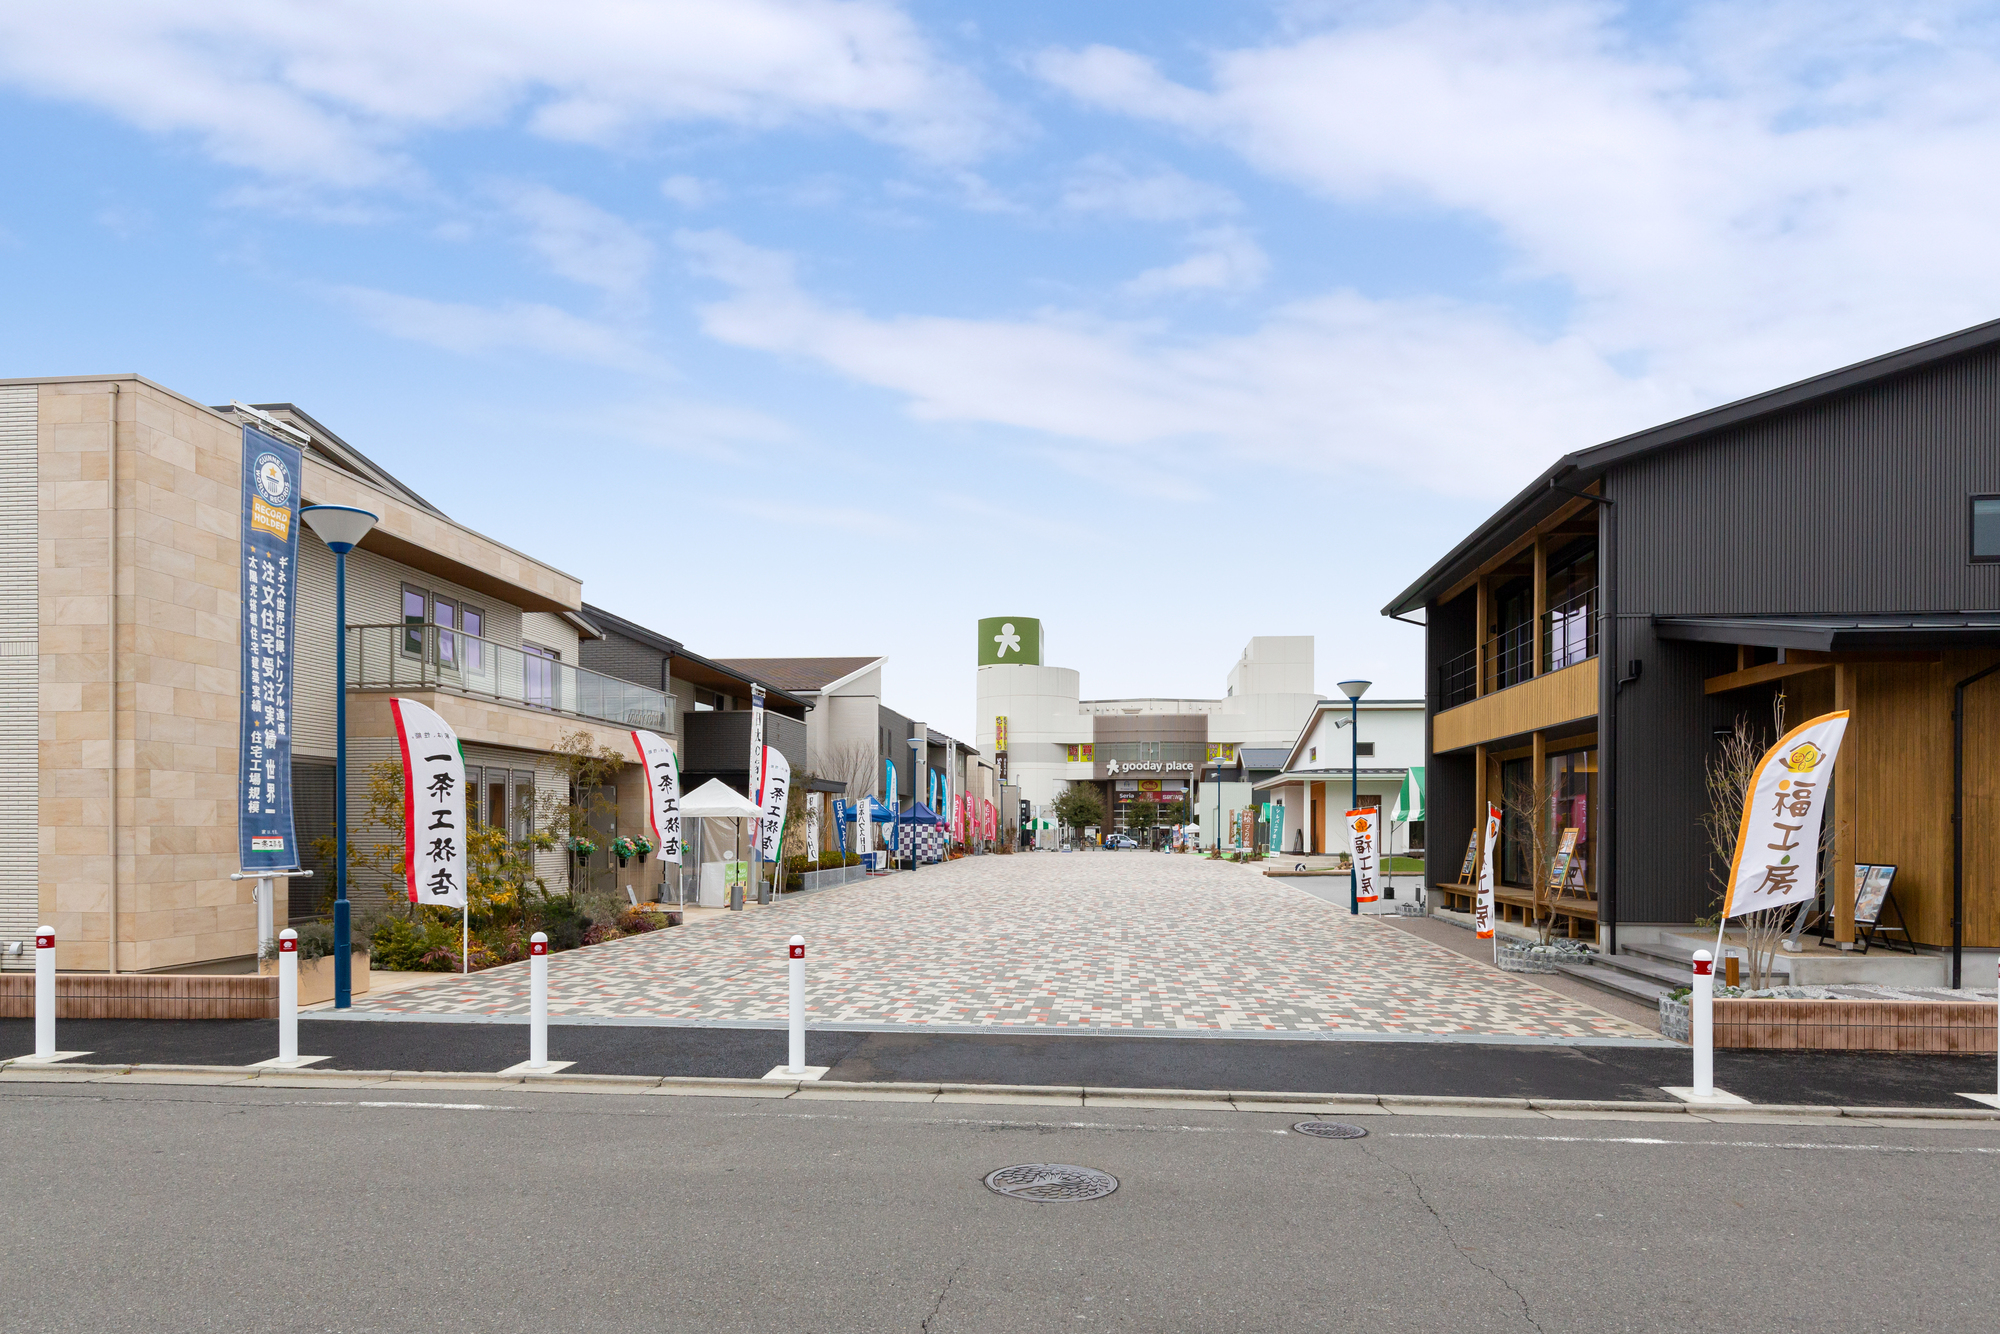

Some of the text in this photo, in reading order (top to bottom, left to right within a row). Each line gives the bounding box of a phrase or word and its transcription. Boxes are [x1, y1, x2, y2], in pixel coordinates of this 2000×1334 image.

[259, 455, 287, 475] GUINNESS
[255, 469, 290, 504] WORLD RECORDS
[254, 513, 286, 532] HOLDER
[255, 503, 288, 522] RECORD
[261, 560, 277, 750] 注文住宅受注実績
[248, 731, 262, 814] 住宅工場規模
[1122, 761, 1194, 773] gooday place
[265, 759, 276, 814] 世界一
[1754, 779, 1816, 895] 福工房
